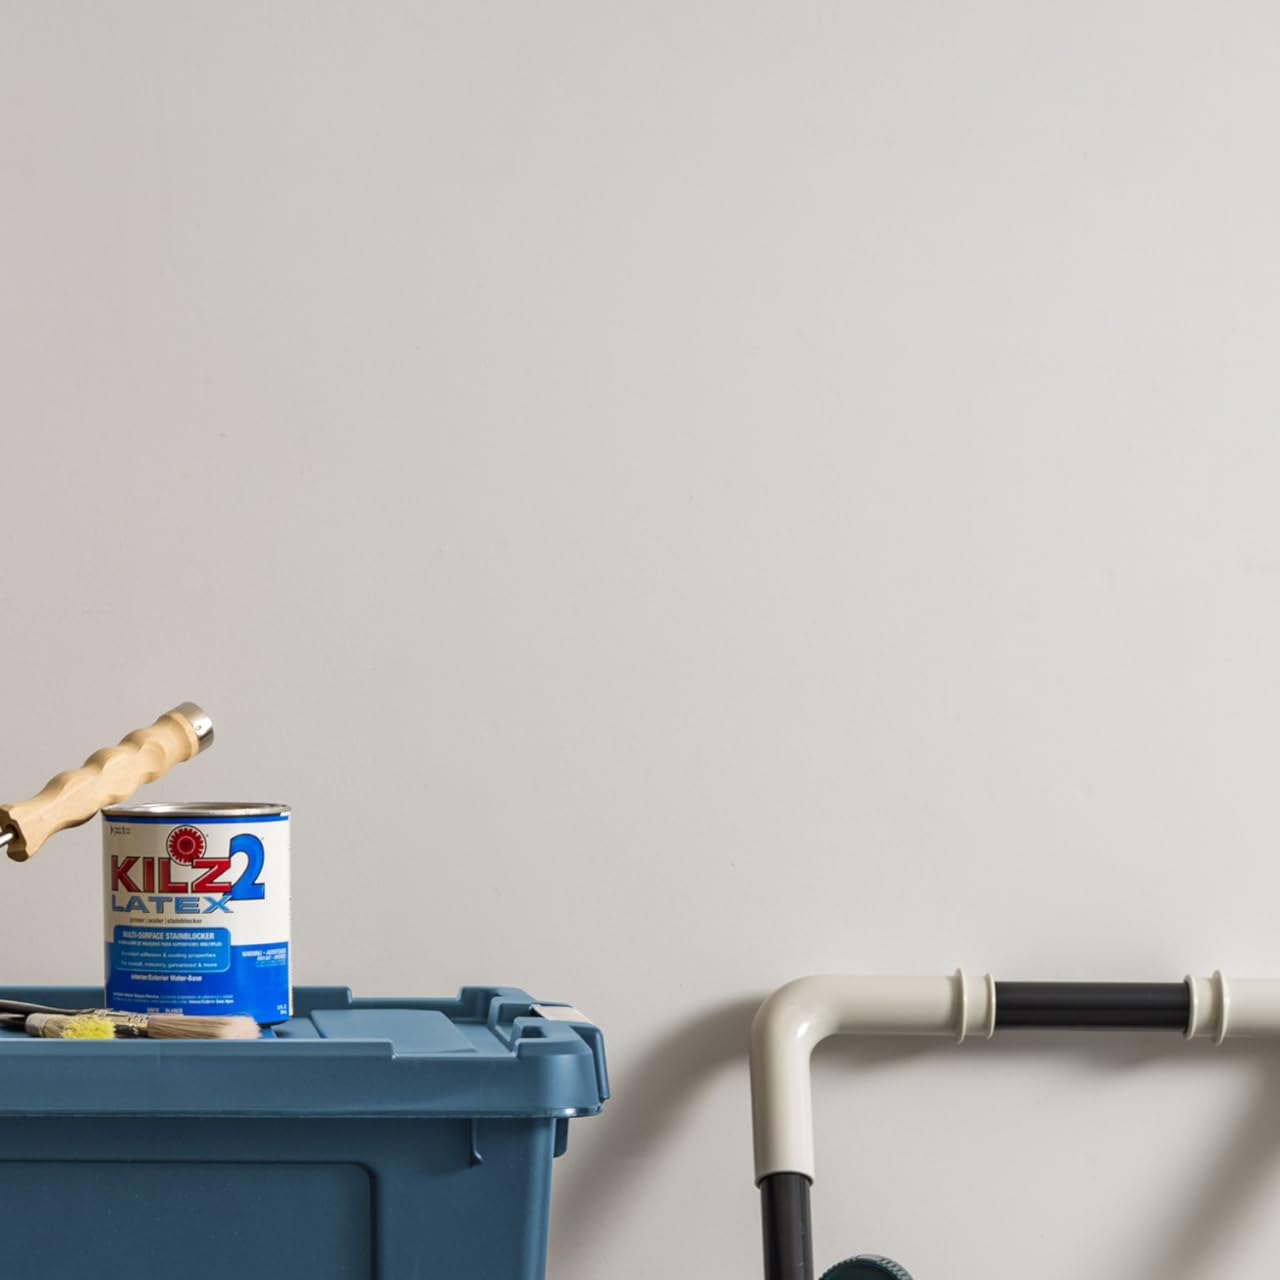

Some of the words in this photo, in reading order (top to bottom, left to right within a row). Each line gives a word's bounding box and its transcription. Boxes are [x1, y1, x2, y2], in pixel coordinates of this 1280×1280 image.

[111, 855, 232, 893] KILZ
[223, 833, 265, 900] 2
[112, 895, 234, 914] LATEX
